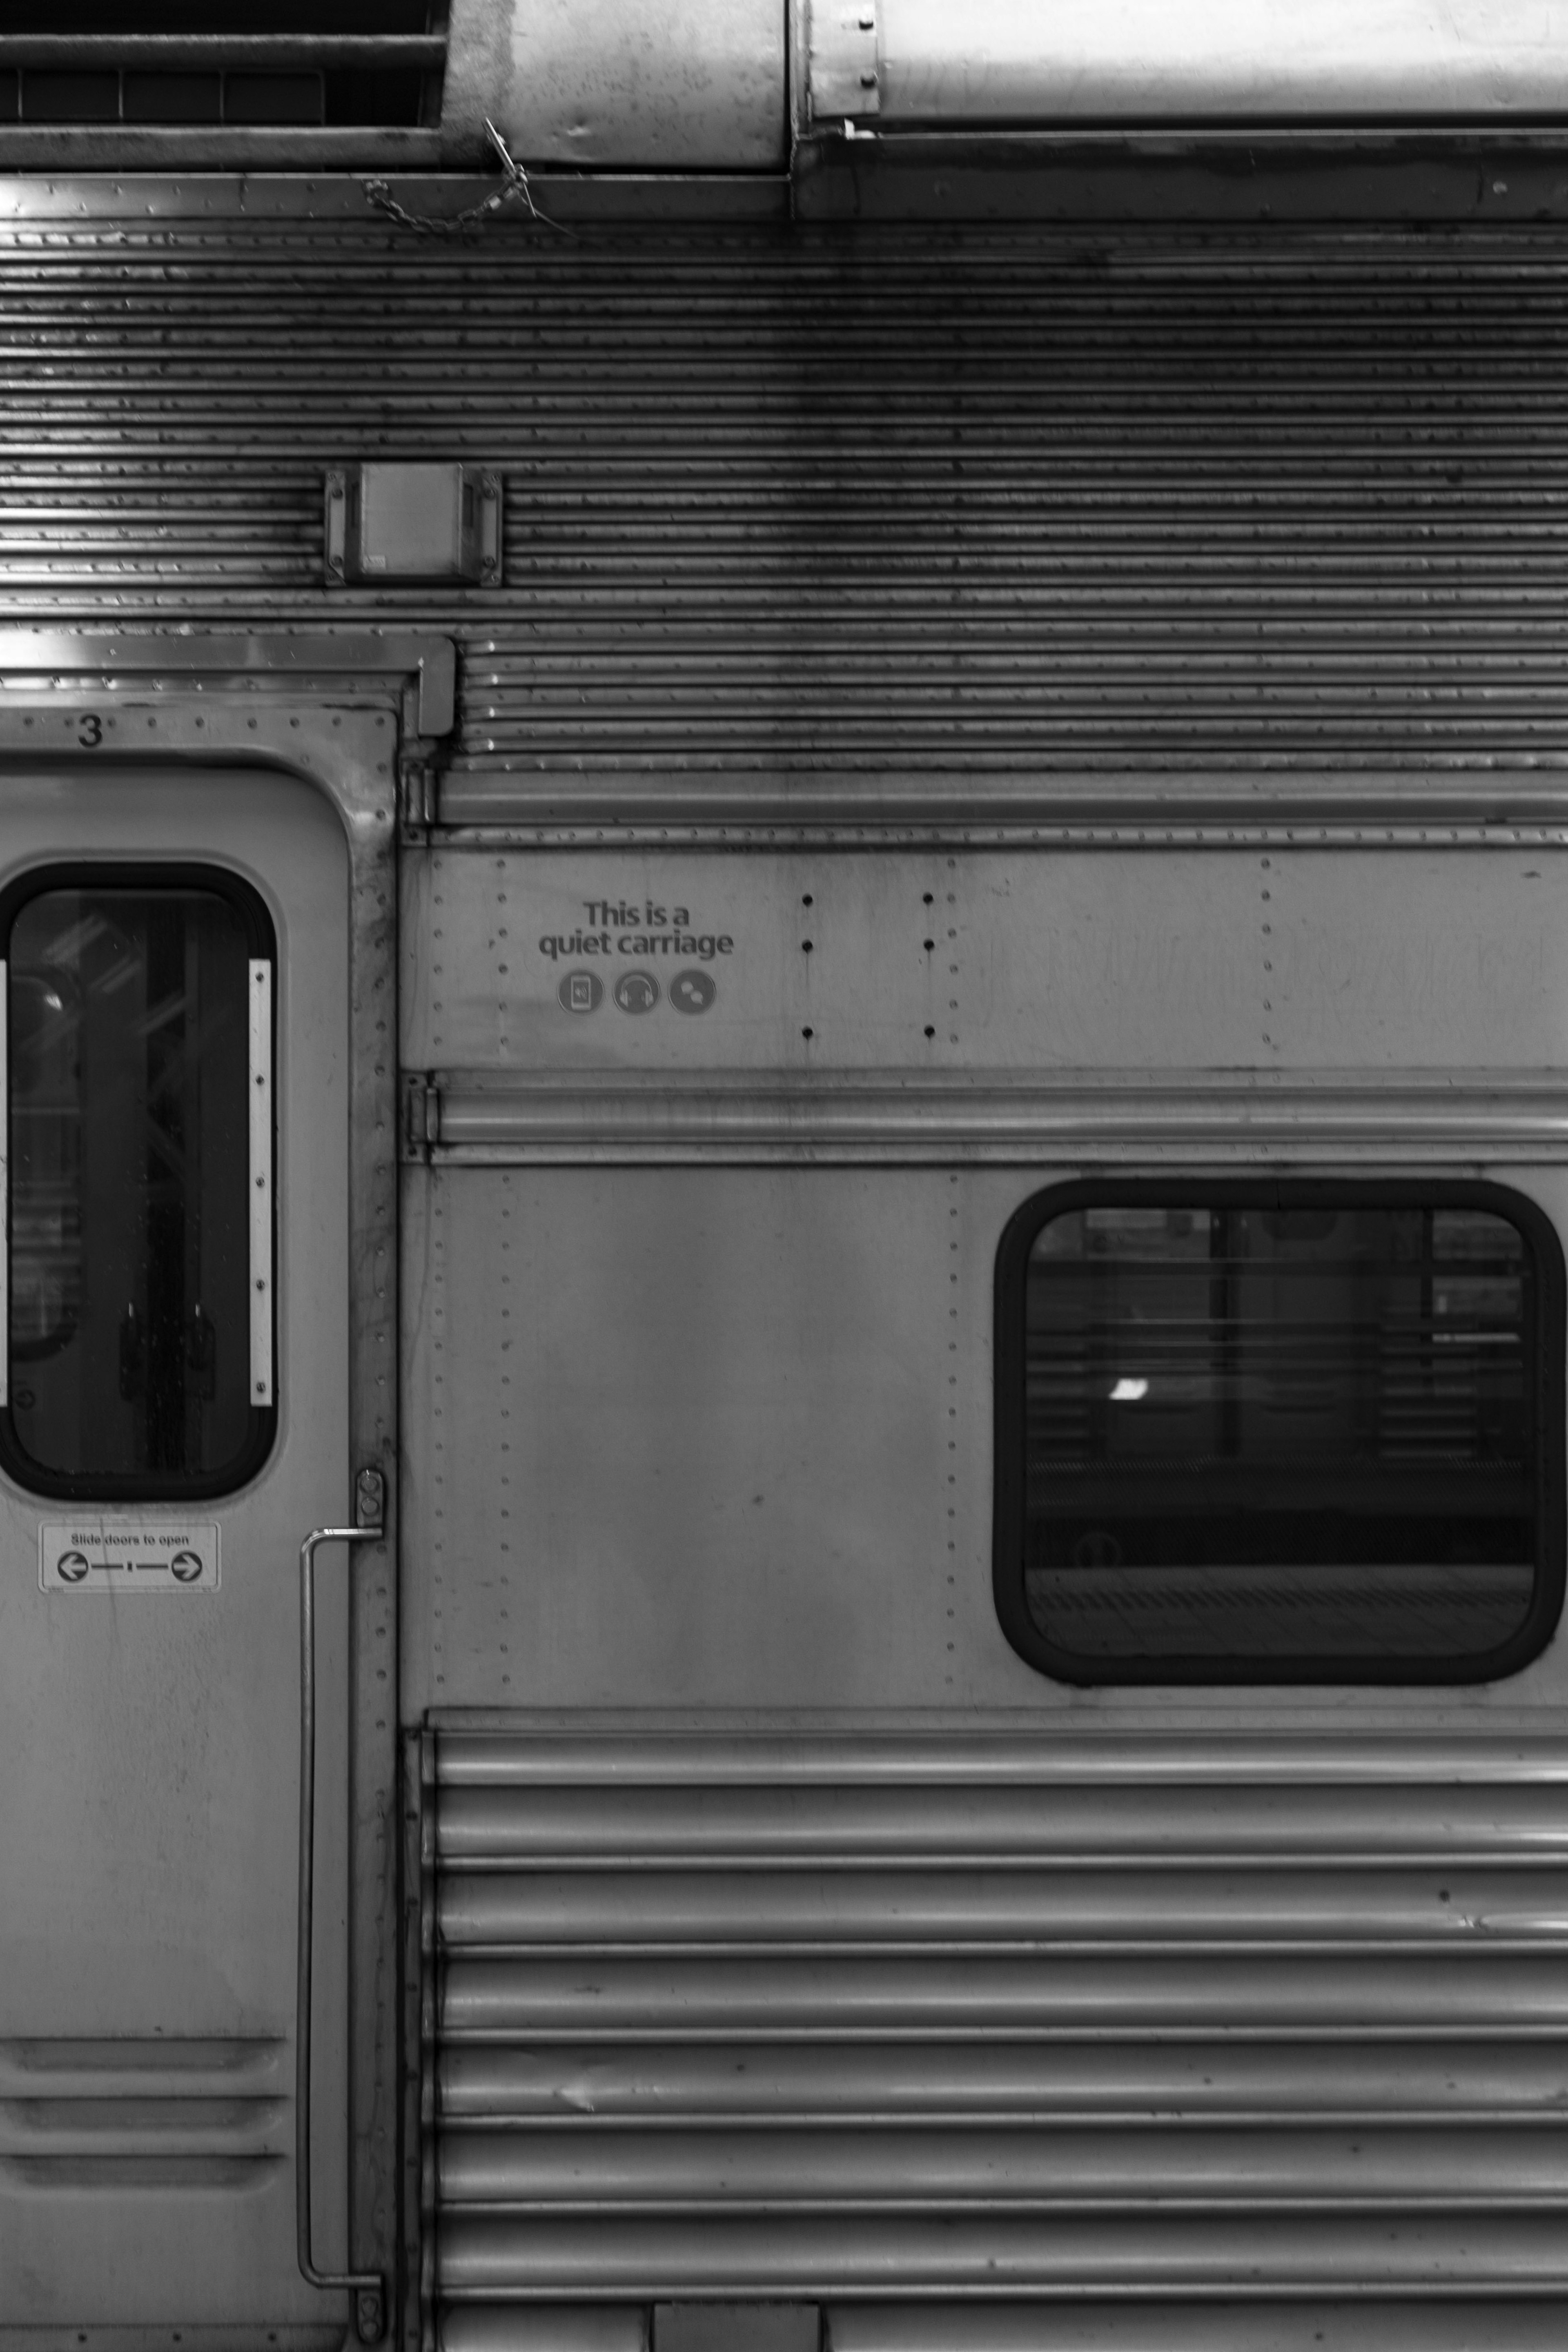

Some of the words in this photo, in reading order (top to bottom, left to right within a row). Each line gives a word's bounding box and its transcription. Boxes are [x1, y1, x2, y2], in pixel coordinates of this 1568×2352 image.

[78, 713, 102, 747] 3
[583, 900, 640, 927] This
[646, 900, 666, 927] is
[673, 906, 690, 927] a
[539, 929, 612, 961] quiet
[617, 929, 734, 961] carriage
[71, 1533, 101, 1546] Slide
[105, 1533, 140, 1546] doors
[143, 1534, 155, 1545] to
[159, 1535, 189, 1547] open
